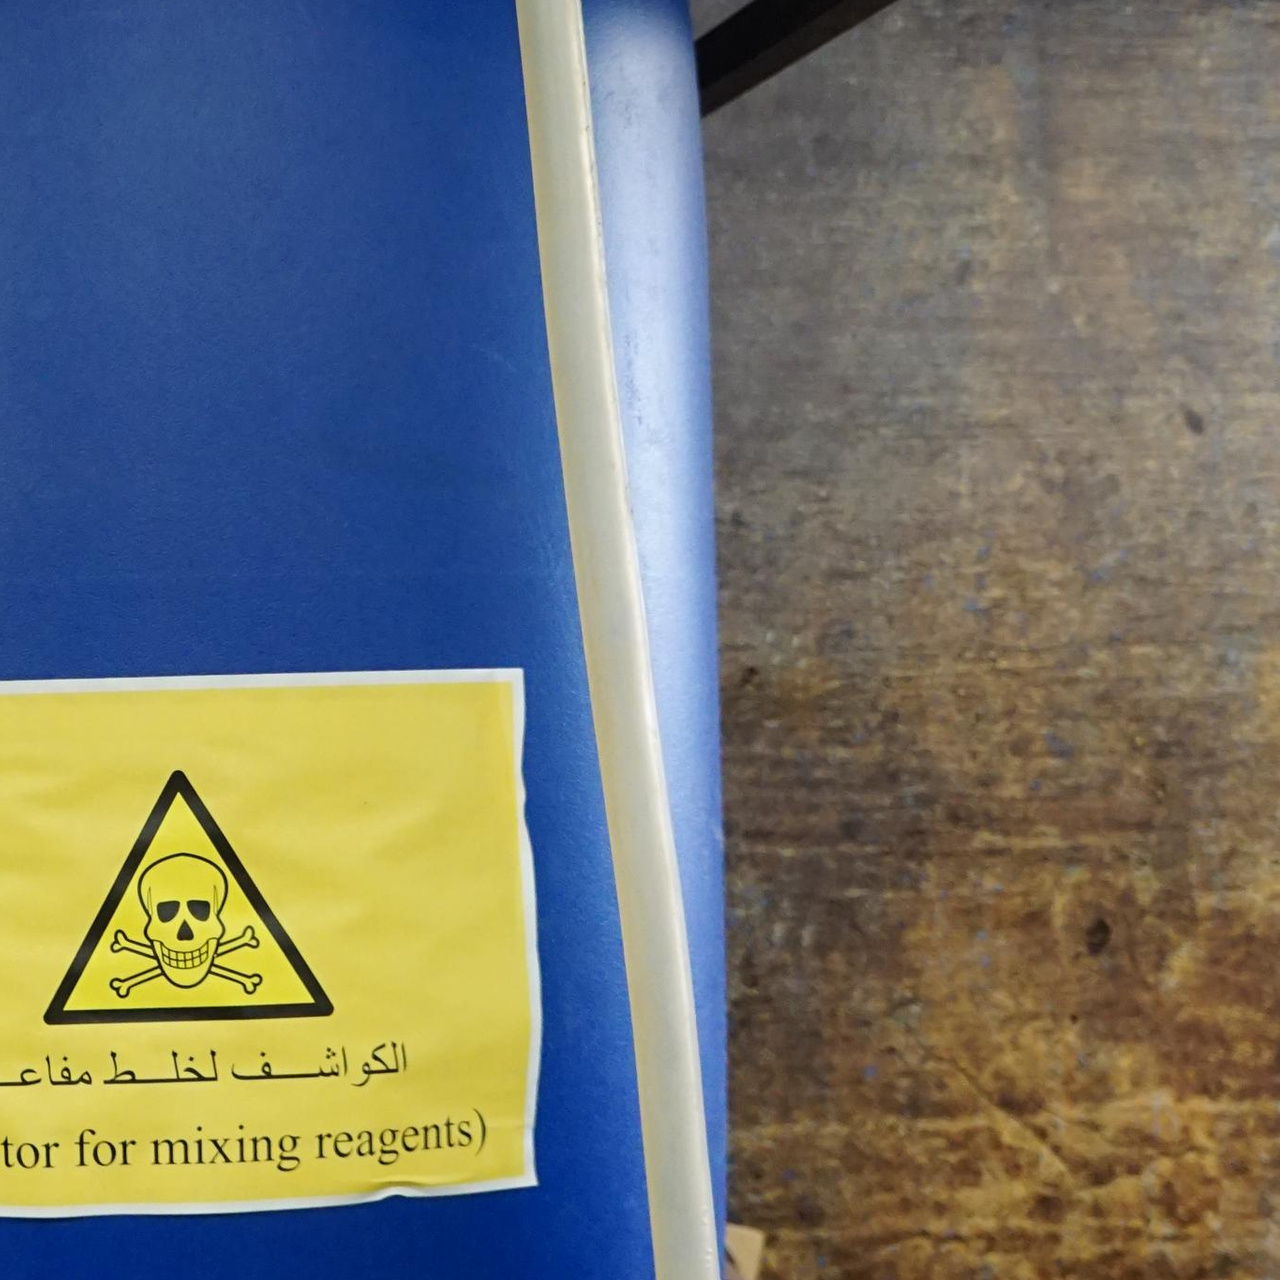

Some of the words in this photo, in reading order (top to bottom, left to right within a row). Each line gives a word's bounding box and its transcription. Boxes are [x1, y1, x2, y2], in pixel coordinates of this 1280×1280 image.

[74, 1128, 137, 1167] for
[150, 1124, 301, 1173] mixing
[315, 1108, 487, 1166] reagents)
